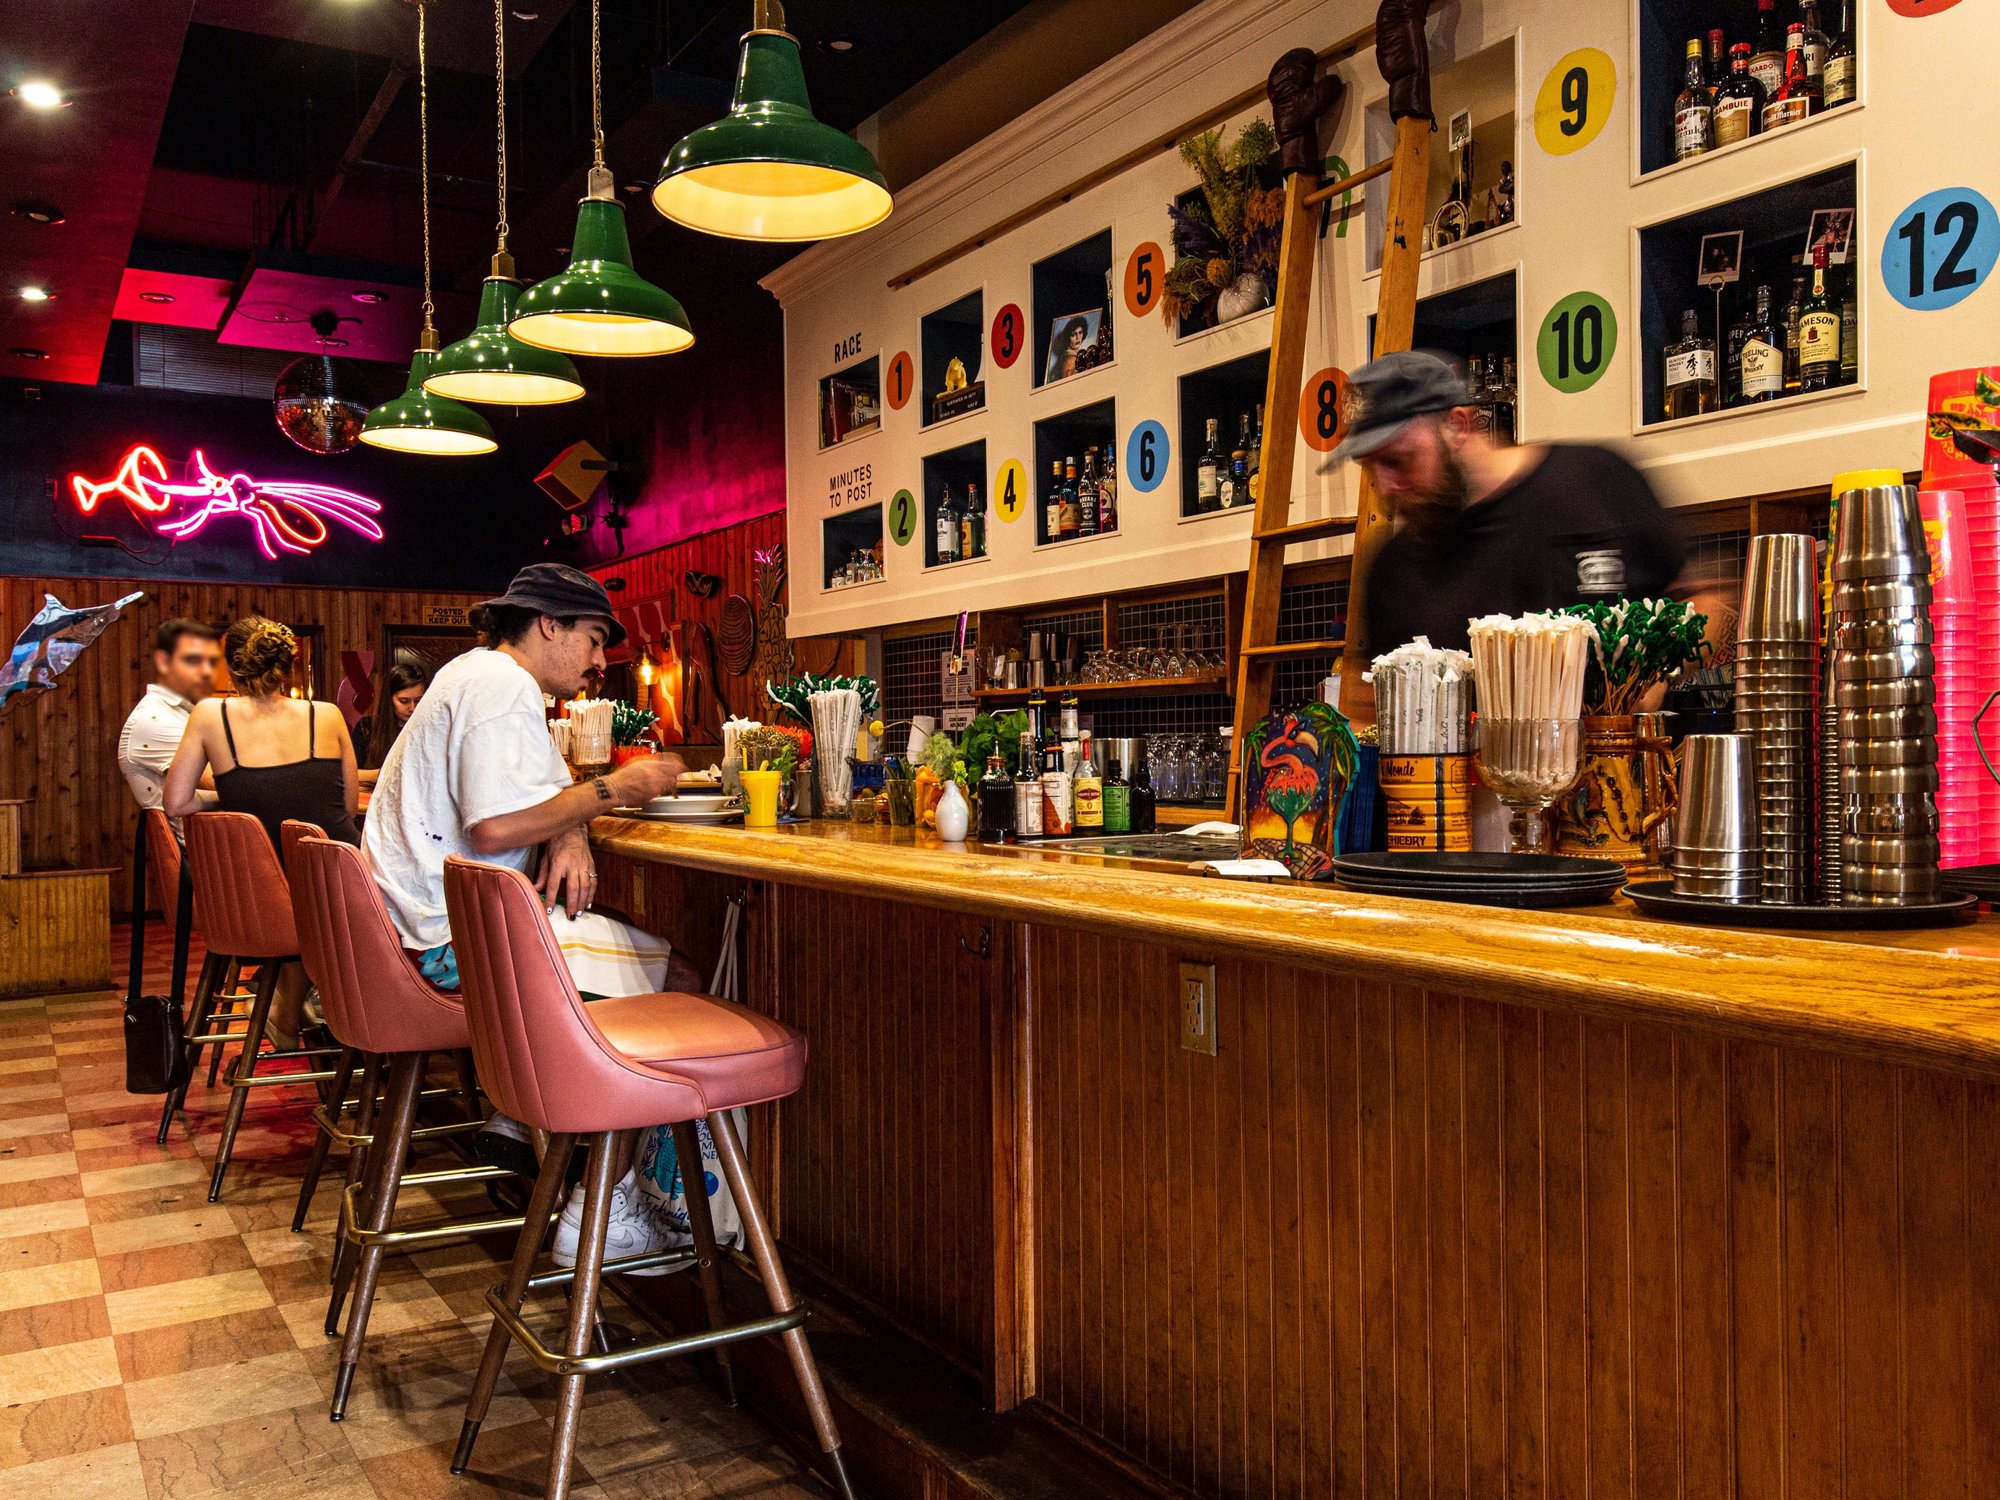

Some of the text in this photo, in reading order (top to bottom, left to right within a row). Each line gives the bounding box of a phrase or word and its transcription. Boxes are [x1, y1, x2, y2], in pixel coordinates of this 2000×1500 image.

[1751, 63, 1774, 74] XARDO
[1560, 67, 1588, 137] 9
[1714, 100, 1748, 116] RAMBUIE
[1898, 201, 1979, 298] 12
[1136, 253, 1152, 306] 5
[1001, 312, 1014, 359] 3
[1552, 304, 1602, 380] 10
[1801, 316, 1834, 328] AMESON
[834, 332, 862, 363] RACE
[895, 360, 902, 401] 1
[1317, 380, 1338, 439] 8
[1140, 430, 1155, 482] 6
[829, 463, 872, 491] MINUTES
[829, 482, 872, 508] TO POST
[1003, 468, 1016, 513] 4
[897, 497, 908, 538] 2
[429, 617, 449, 625] KEEP
